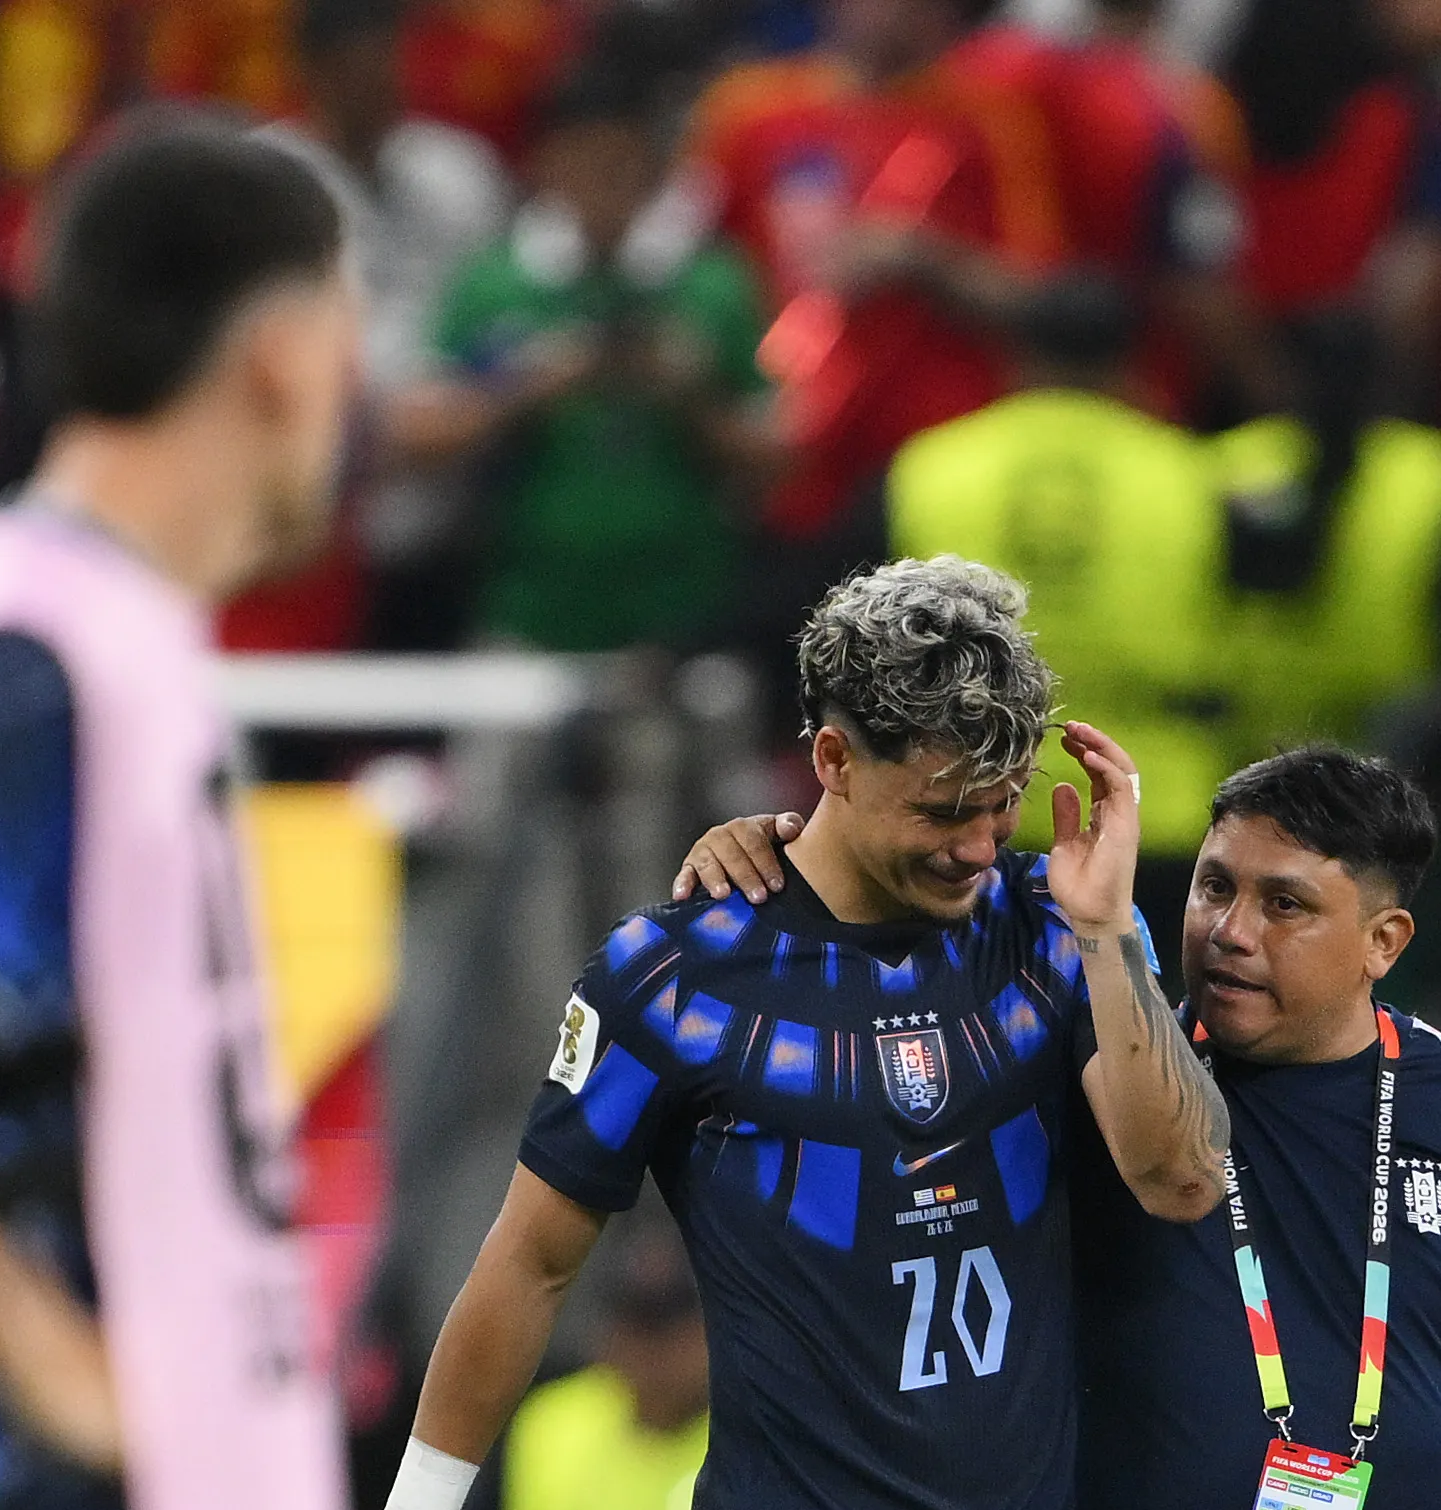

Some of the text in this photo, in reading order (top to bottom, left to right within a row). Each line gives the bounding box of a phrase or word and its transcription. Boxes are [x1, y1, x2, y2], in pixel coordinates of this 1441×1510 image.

[1372, 1070, 1395, 1243] FIFA WORLD CUP 2026
[1229, 1195, 1248, 1231] FIFA
[891, 1245, 1012, 1391] 20
[1272, 1456, 1289, 1466] FIFA
[1289, 1460, 1316, 1473] WORLD
[1316, 1467, 1333, 1477] CUP
